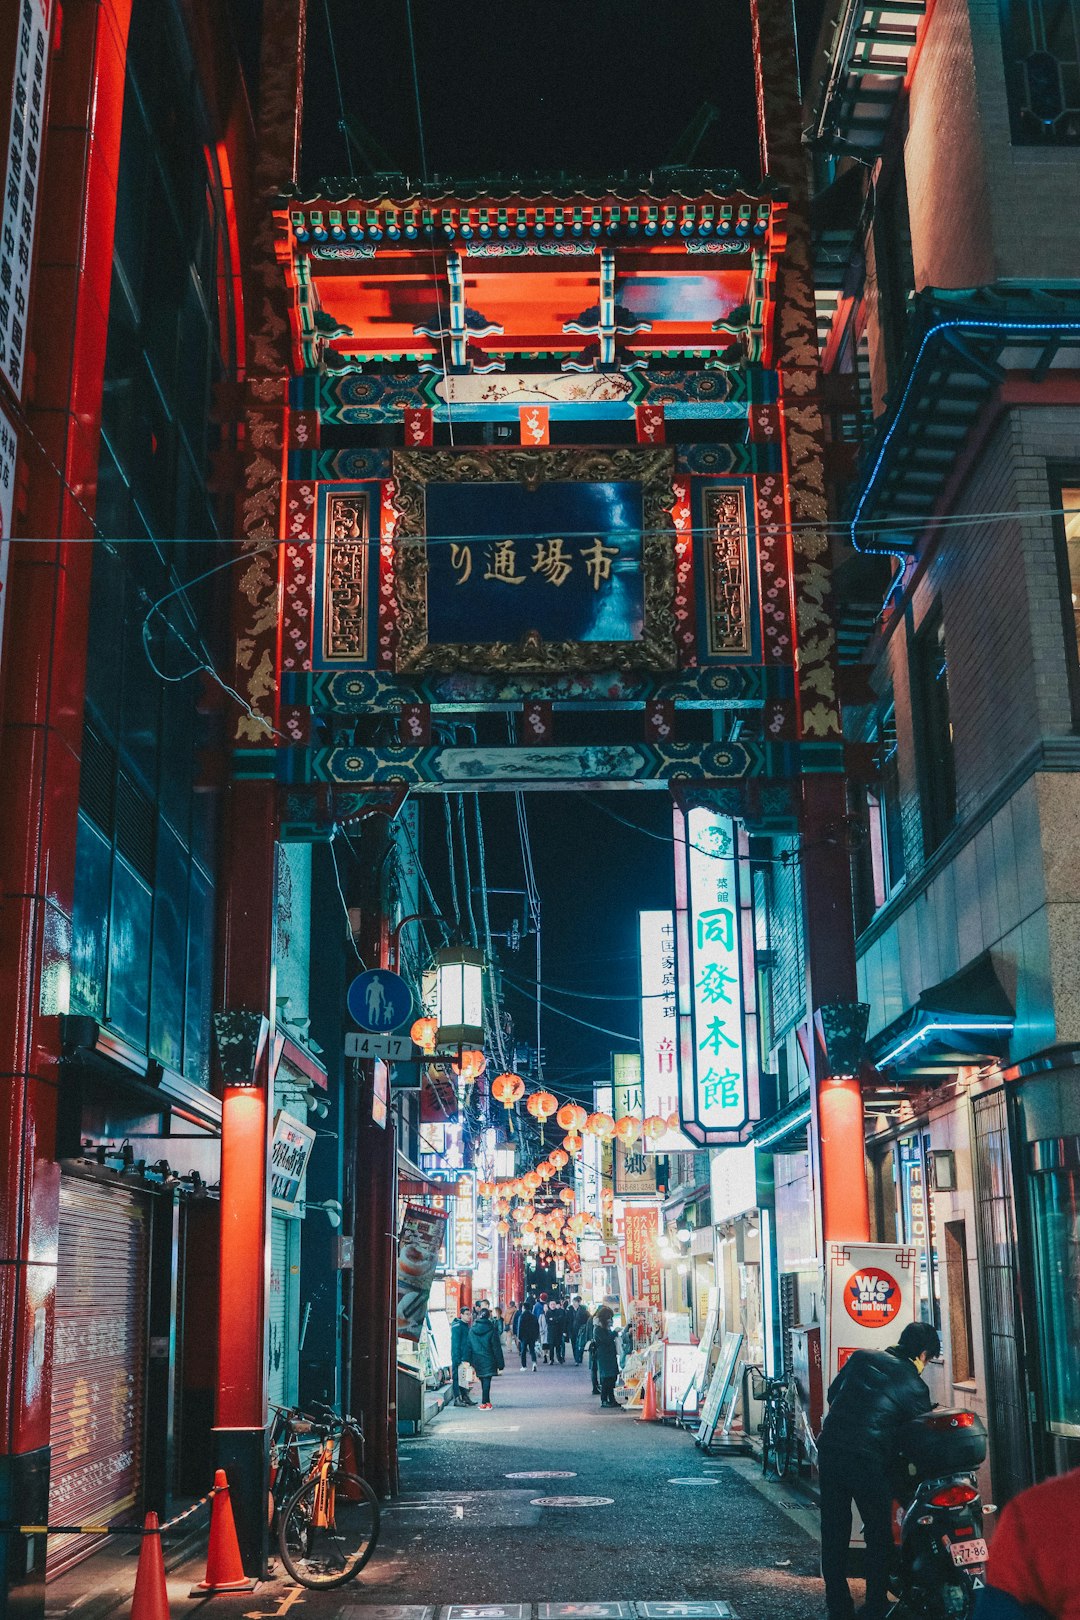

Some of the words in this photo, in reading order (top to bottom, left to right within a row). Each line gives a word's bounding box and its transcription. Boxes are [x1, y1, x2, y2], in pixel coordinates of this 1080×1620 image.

[696, 908, 739, 1110] 同發本館
[355, 1038, 402, 1055] 14-17
[855, 1275, 890, 1293] We
[859, 1290, 886, 1302] are
[851, 1299, 873, 1311] China
[873, 1301, 894, 1312] Town.
